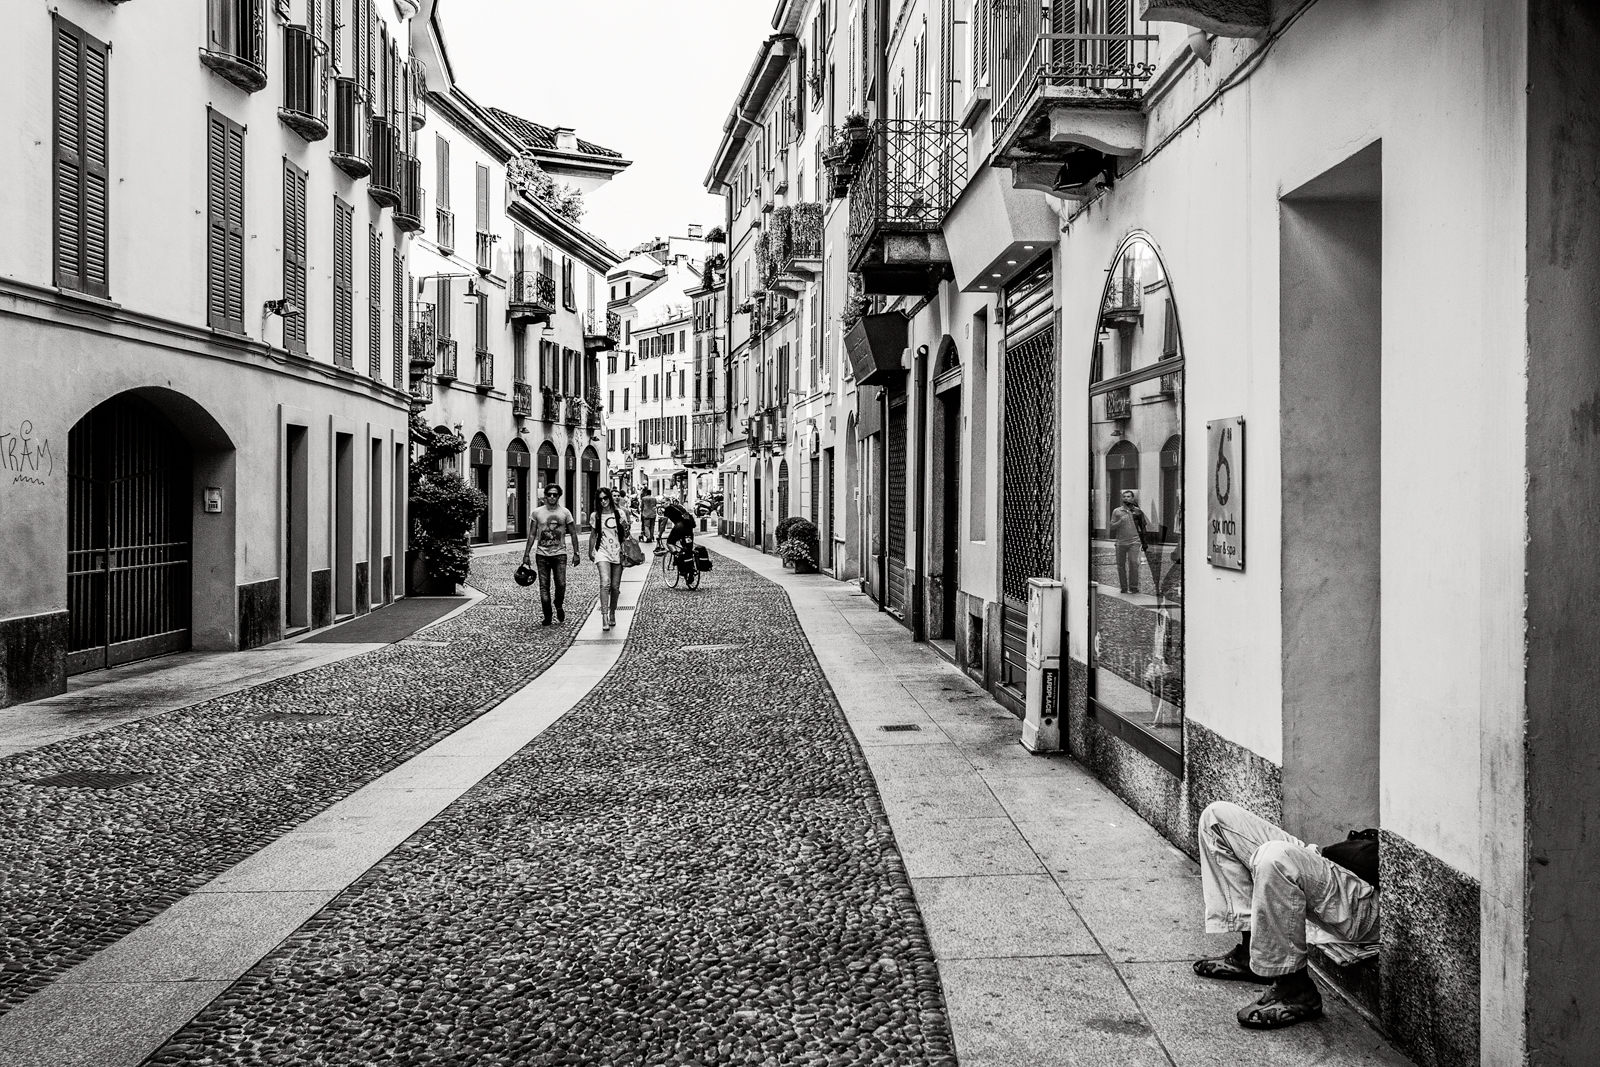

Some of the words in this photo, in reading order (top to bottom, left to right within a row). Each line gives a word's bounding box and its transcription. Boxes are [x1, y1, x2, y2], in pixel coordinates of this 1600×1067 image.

[1212, 519, 1221, 535] six
[1222, 513, 1236, 536] inch
[1212, 540, 1222, 554] hair
[1223, 541, 1226, 555] &
[1227, 545, 1236, 559] spa
[1045, 672, 1053, 714] HARDPLACE
